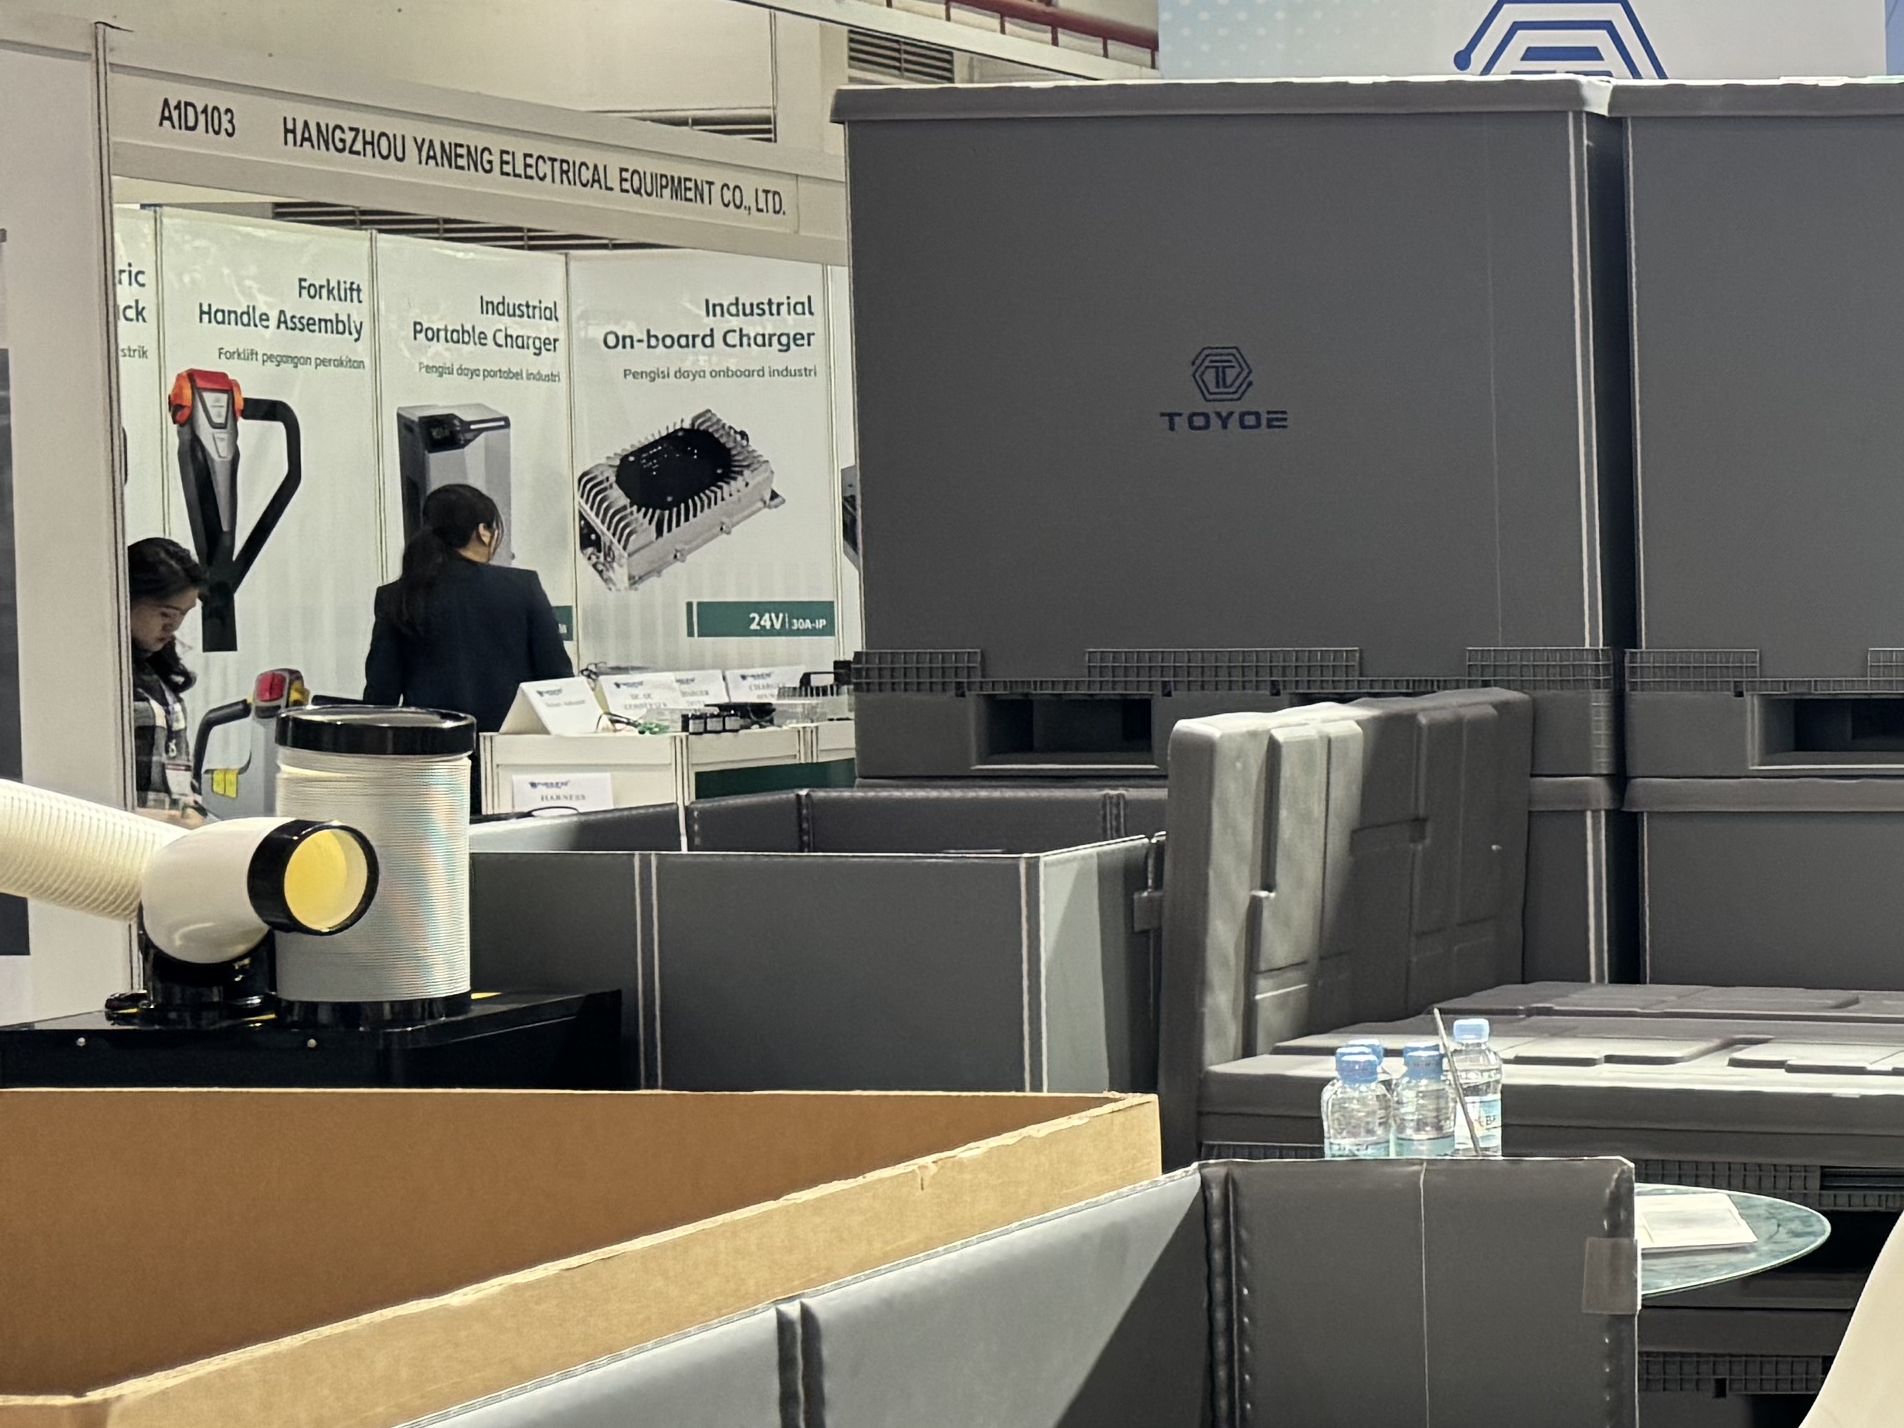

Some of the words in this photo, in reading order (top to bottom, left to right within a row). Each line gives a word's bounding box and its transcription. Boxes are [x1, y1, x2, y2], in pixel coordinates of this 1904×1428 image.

[158, 97, 236, 139] A1D103
[282, 115, 406, 164] HANGZHOU
[413, 135, 494, 174] YANENG
[499, 148, 615, 192] ELECTRICAL
[618, 166, 716, 206] EQUIPMENT
[719, 182, 752, 216] CO.,
[755, 187, 786, 217] LTD.
[297, 276, 363, 304] Forklift
[479, 294, 560, 323] Industrial
[704, 294, 815, 318] Industrial
[198, 302, 270, 329] Handle
[275, 308, 364, 343] Assembly
[412, 320, 488, 347] Portable
[492, 326, 560, 357] Charger
[602, 327, 716, 350] On-board
[721, 327, 816, 353] Charger
[217, 346, 259, 363] Forklift
[418, 360, 454, 378] Pengisi
[623, 367, 670, 383] Pengisi
[673, 366, 707, 382] daya
[709, 366, 766, 379] onboard
[768, 364, 818, 379] industri
[1159, 409, 1290, 433] TOYOE
[748, 611, 784, 630] 24V
